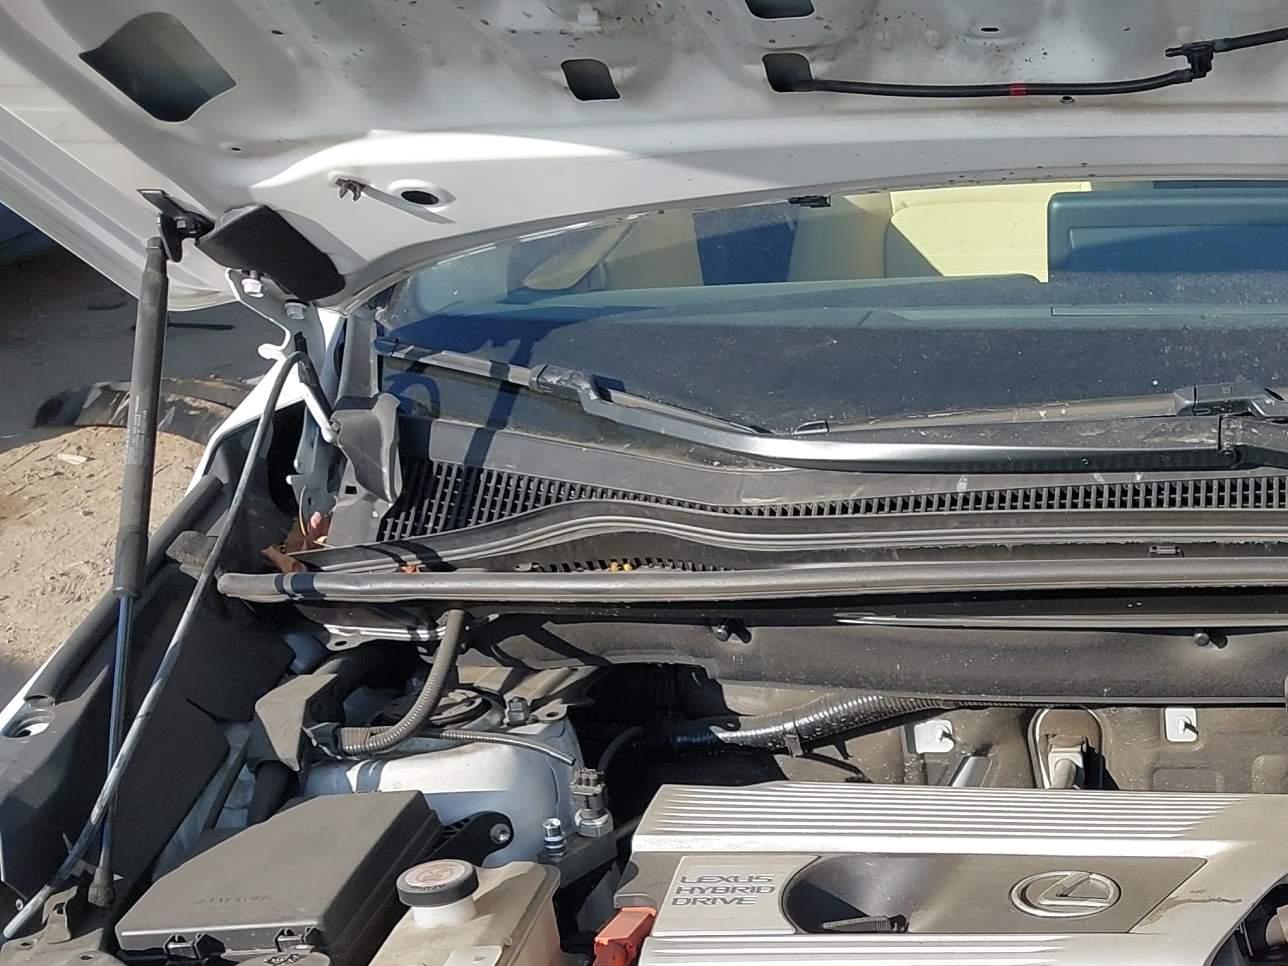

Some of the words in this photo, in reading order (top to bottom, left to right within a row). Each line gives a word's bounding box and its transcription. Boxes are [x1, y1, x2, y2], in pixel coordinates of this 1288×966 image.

[680, 875, 775, 884] LEXUS
[676, 885, 776, 894] HYBRID
[671, 896, 757, 906] DRIVE
